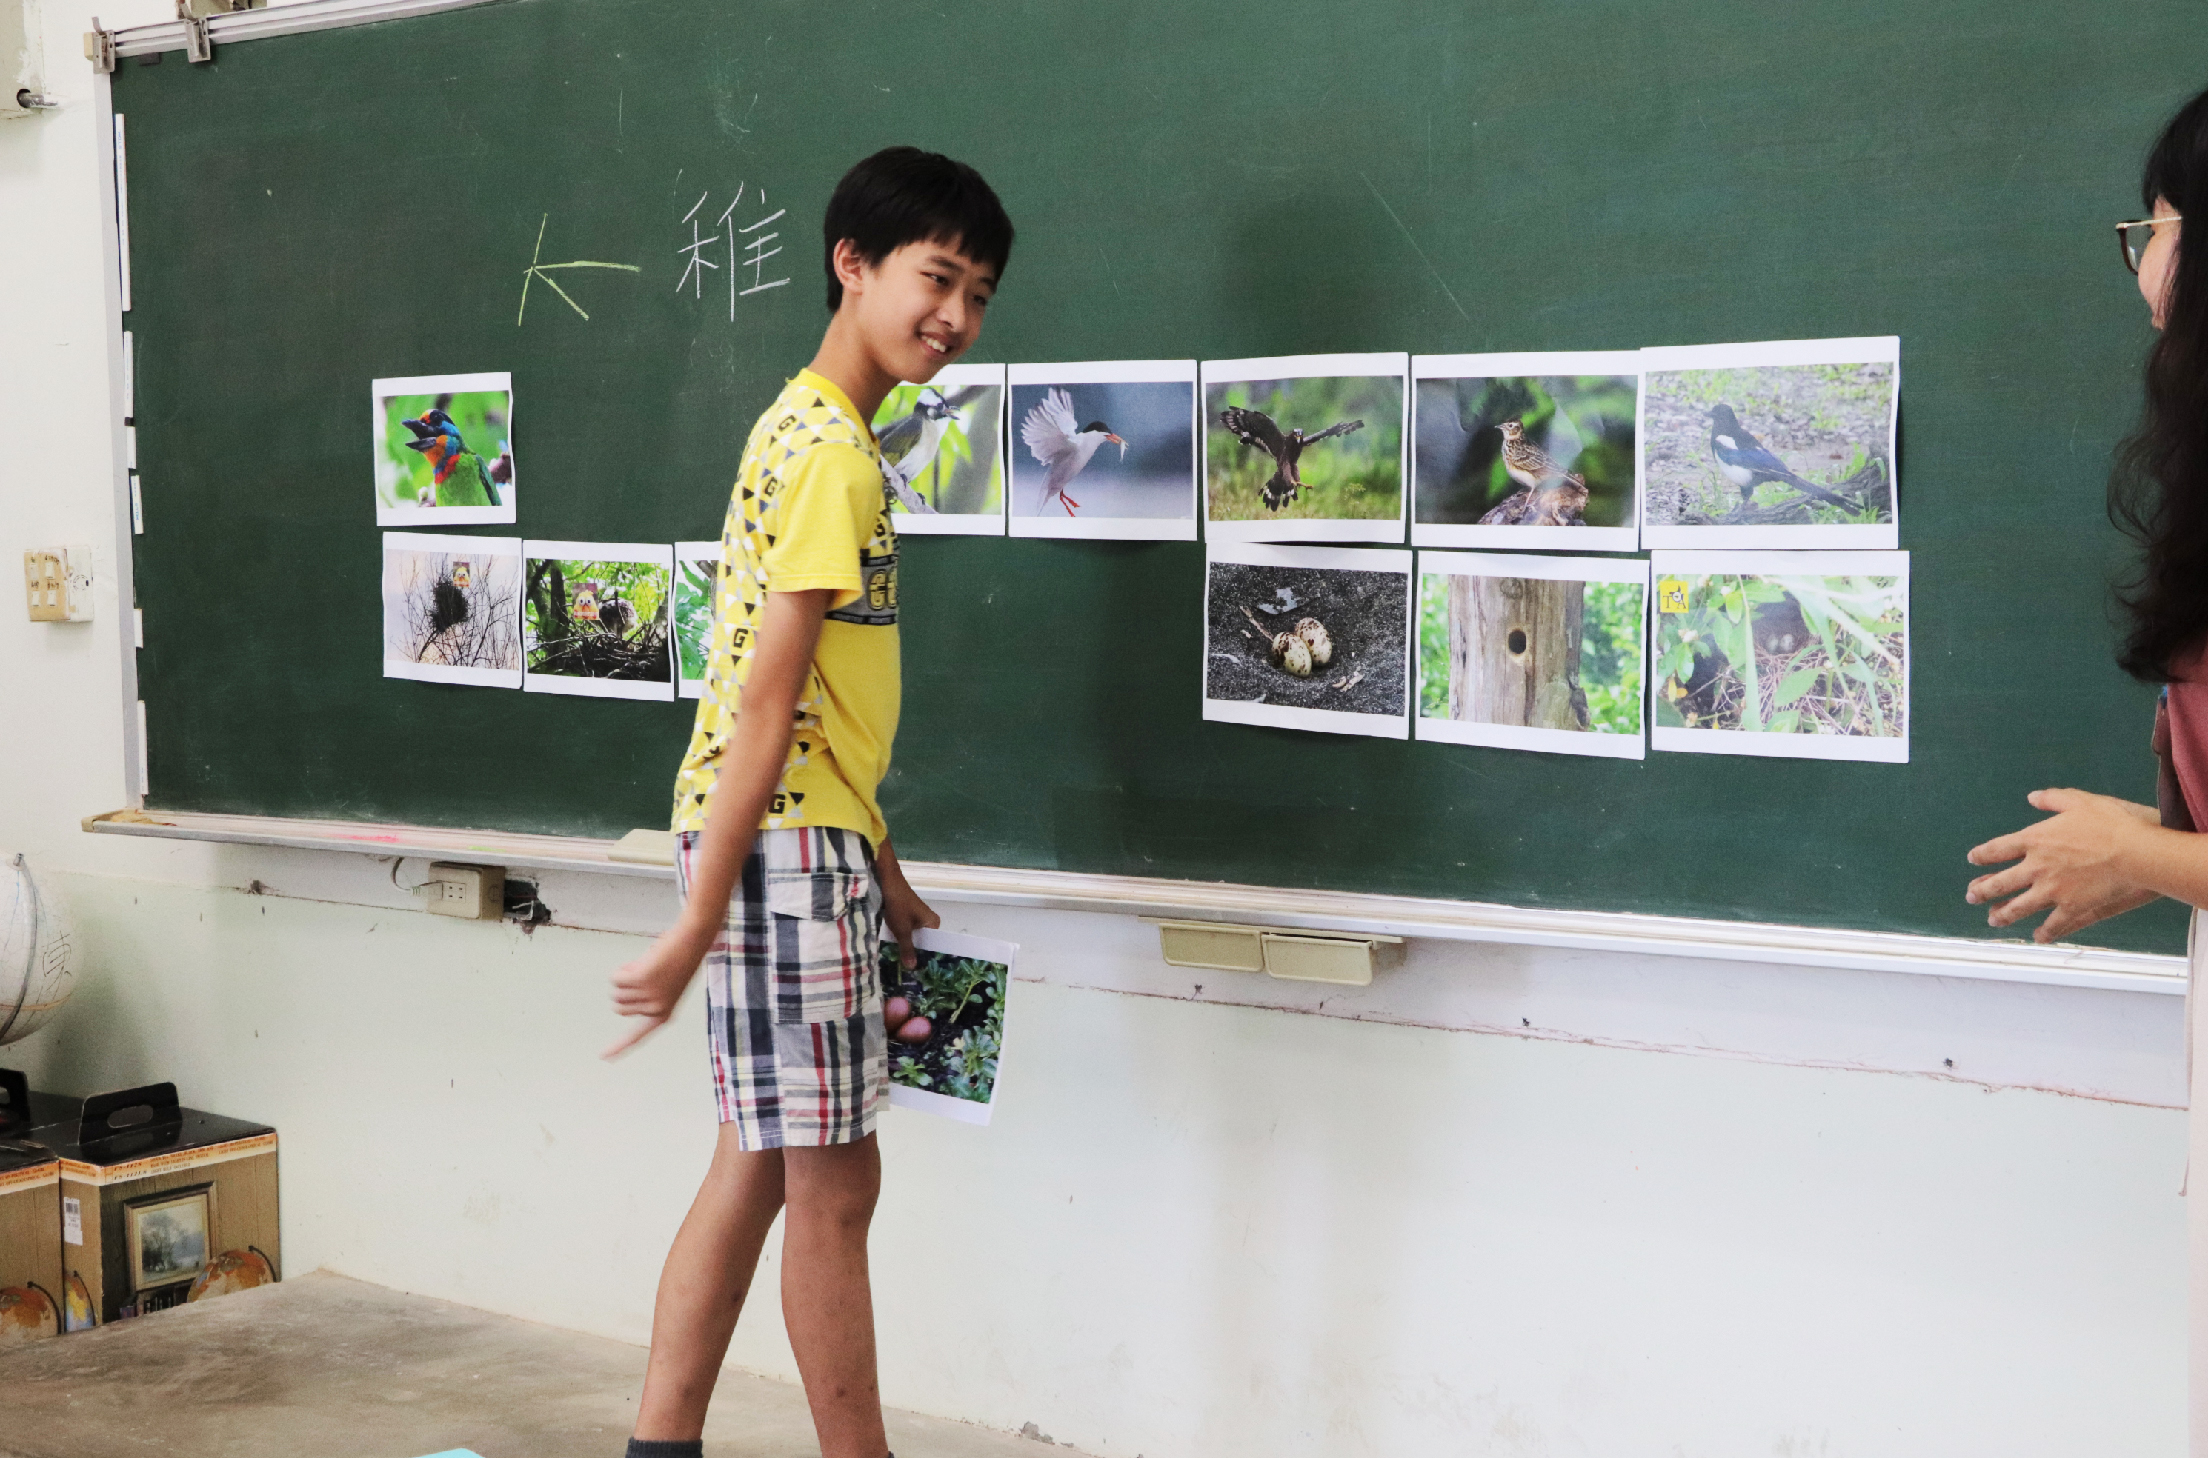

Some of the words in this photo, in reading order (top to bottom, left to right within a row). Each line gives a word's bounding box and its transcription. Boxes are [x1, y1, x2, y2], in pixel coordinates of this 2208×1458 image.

[676, 181, 791, 323] 稚
[778, 414, 796, 432] G
[764, 476, 778, 497] G
[733, 628, 749, 649] G
[768, 793, 786, 814] G
